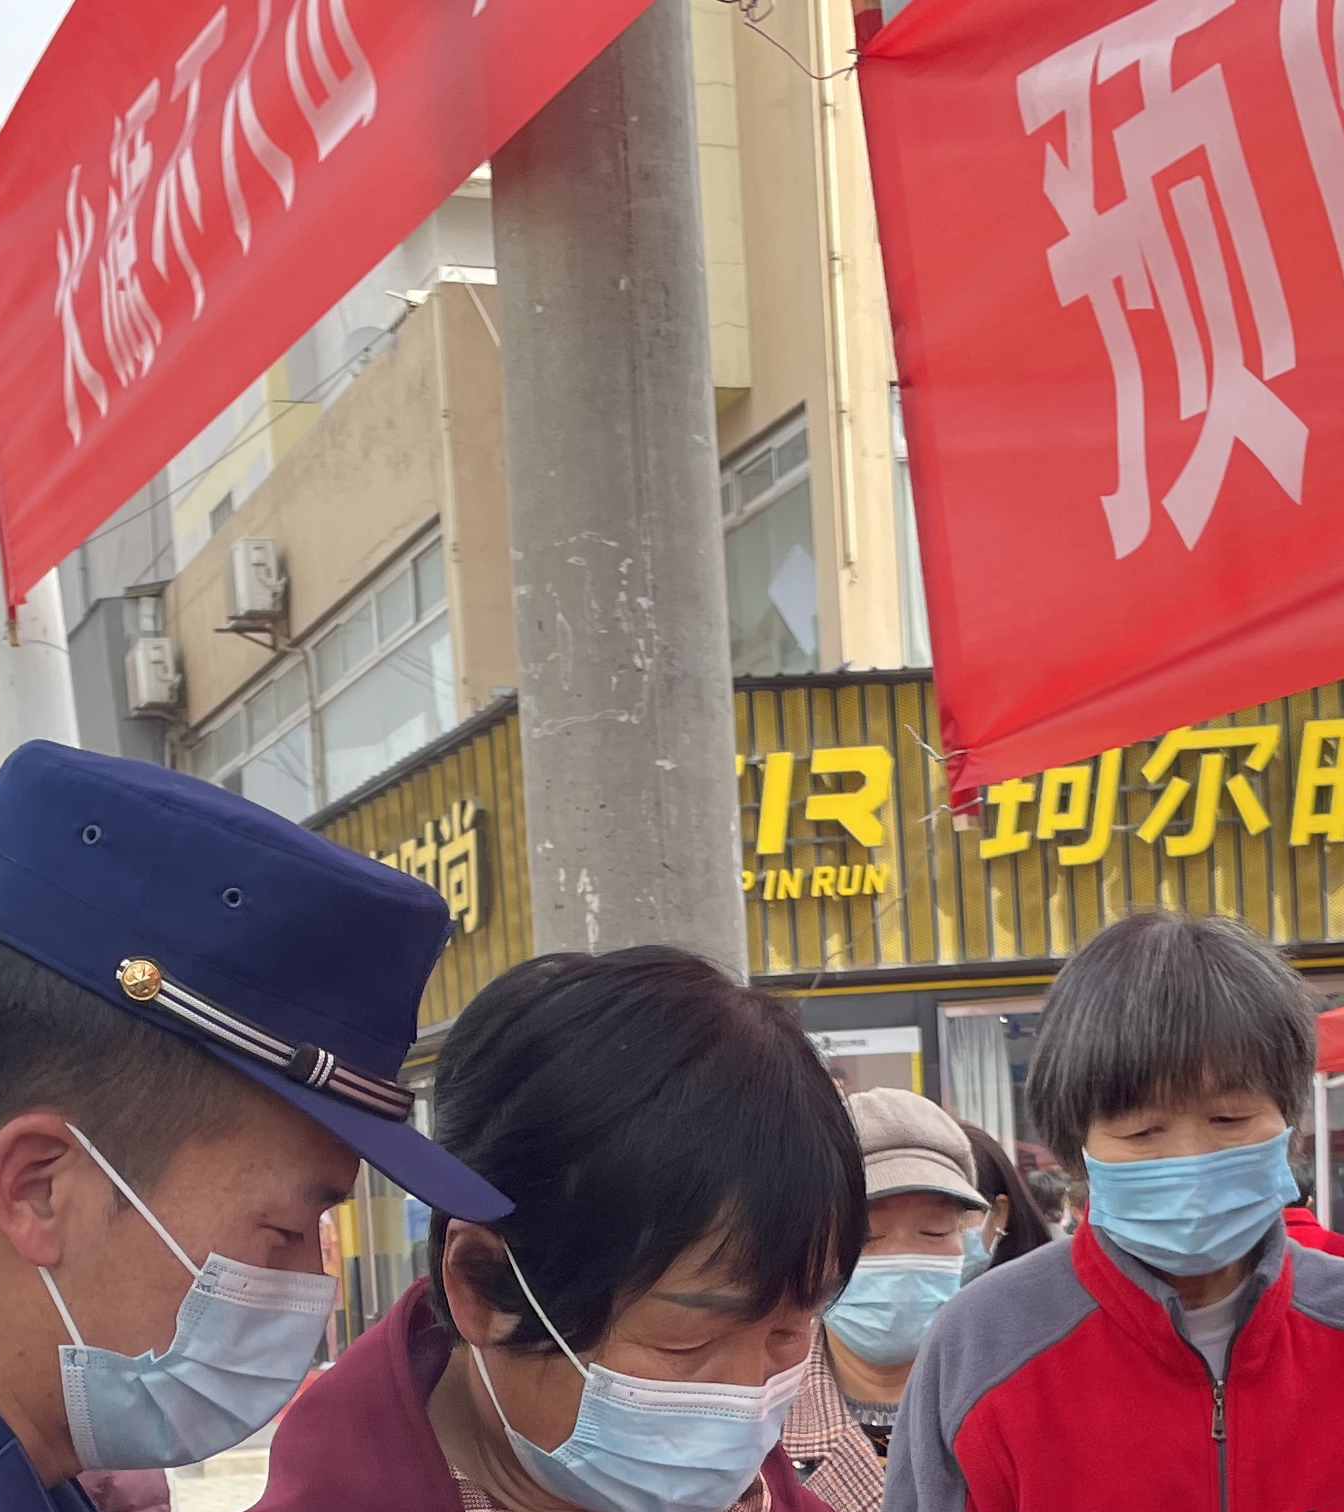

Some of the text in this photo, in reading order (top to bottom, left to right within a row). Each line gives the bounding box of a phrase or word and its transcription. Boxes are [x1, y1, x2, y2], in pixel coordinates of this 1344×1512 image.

[735, 745, 894, 854] IR
[763, 867, 804, 901] IN
[811, 864, 887, 898] RUN
